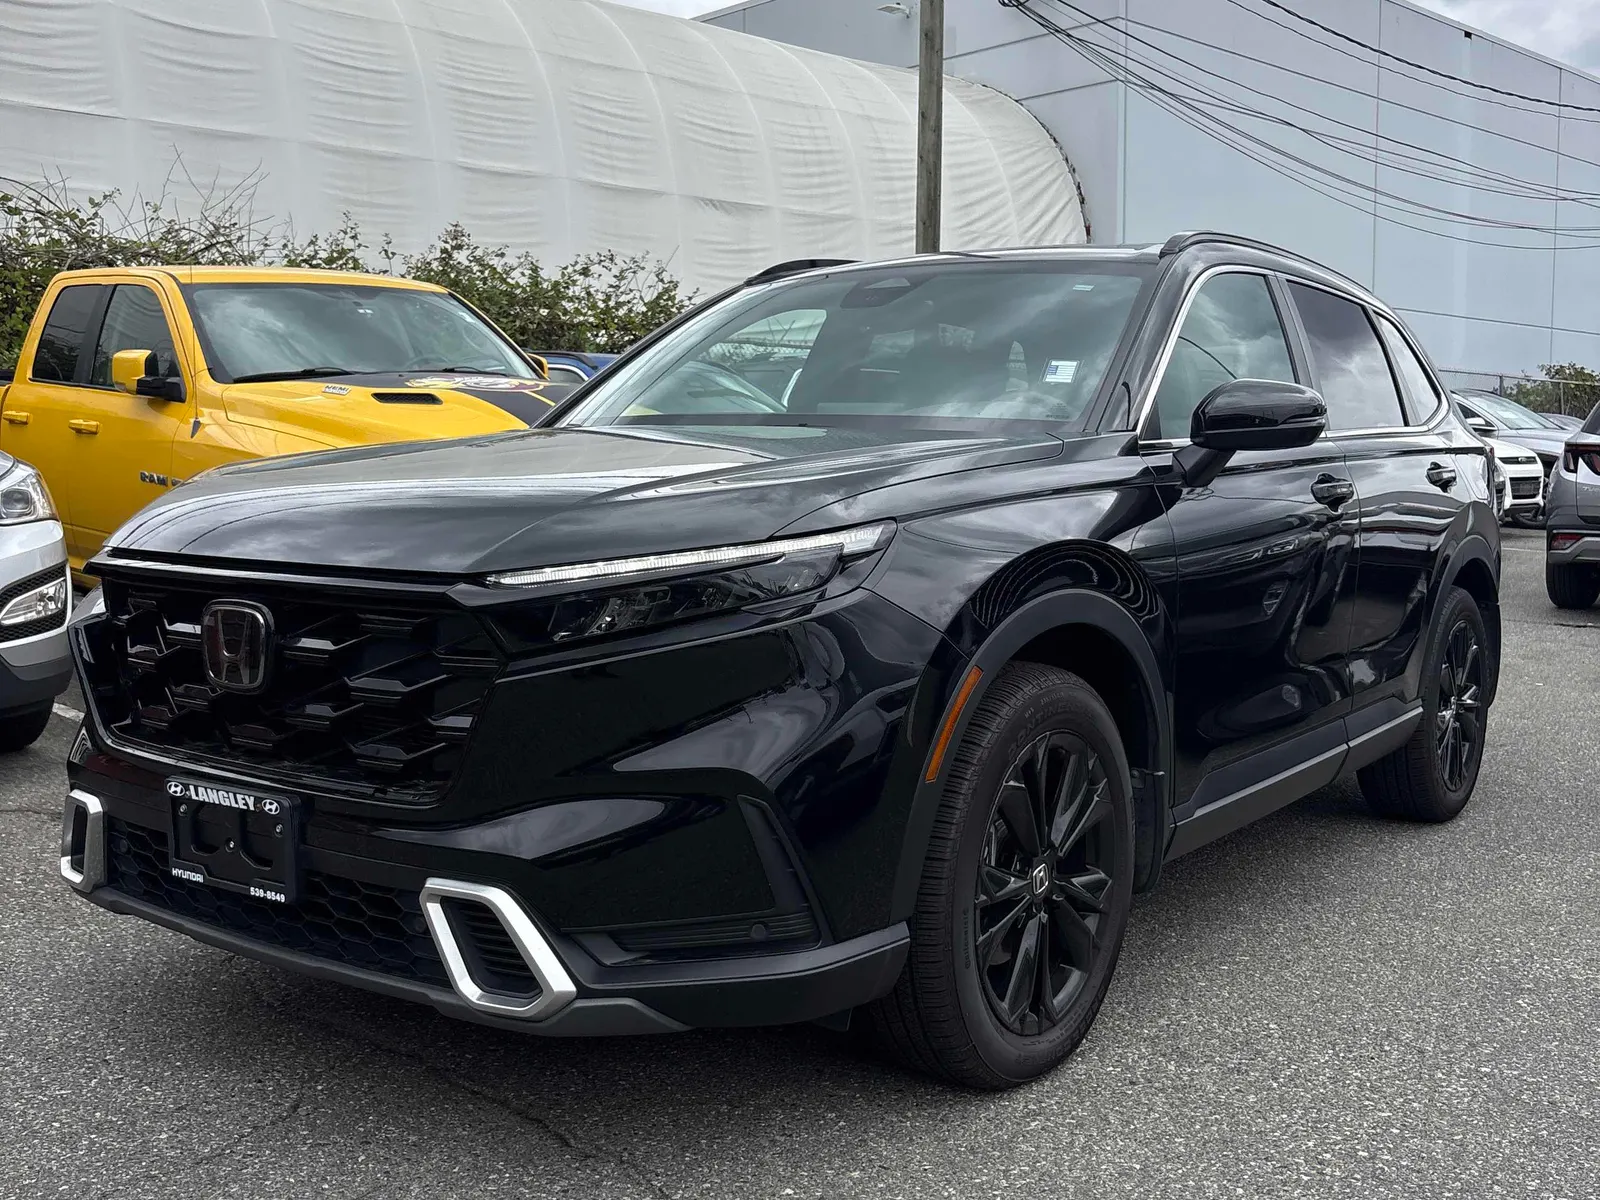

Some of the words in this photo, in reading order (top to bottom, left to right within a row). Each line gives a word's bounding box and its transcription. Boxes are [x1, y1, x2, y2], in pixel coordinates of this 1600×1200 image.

[139, 471, 168, 485] RAM
[189, 784, 255, 811] LANGLEY
[172, 867, 204, 883] HYUNDAI
[249, 886, 286, 903] 539-8549
